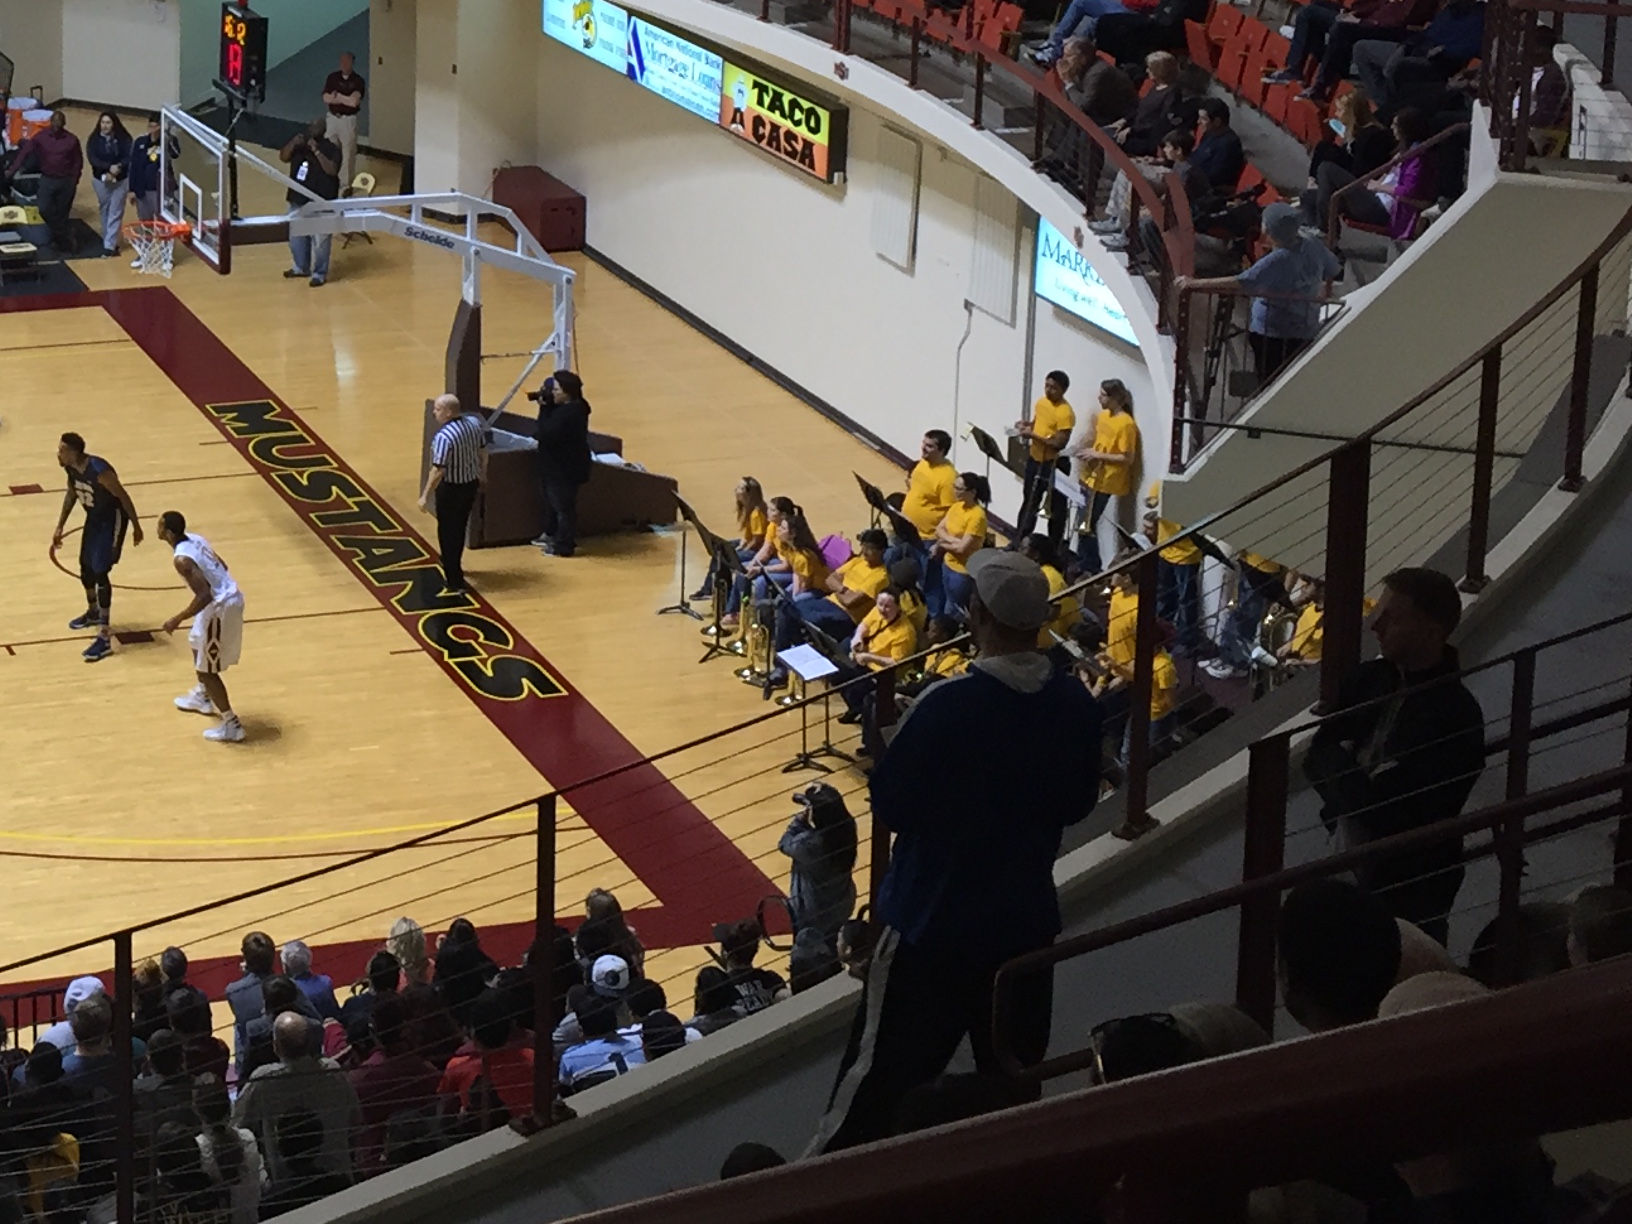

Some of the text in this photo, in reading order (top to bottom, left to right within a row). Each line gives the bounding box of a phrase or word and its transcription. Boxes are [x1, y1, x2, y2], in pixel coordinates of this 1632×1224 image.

[643, 25, 675, 46] American
[675, 40, 703, 63] National
[751, 78, 822, 136] TACO
[751, 113, 817, 171] CASA
[206, 400, 569, 702] MUSTANGS
